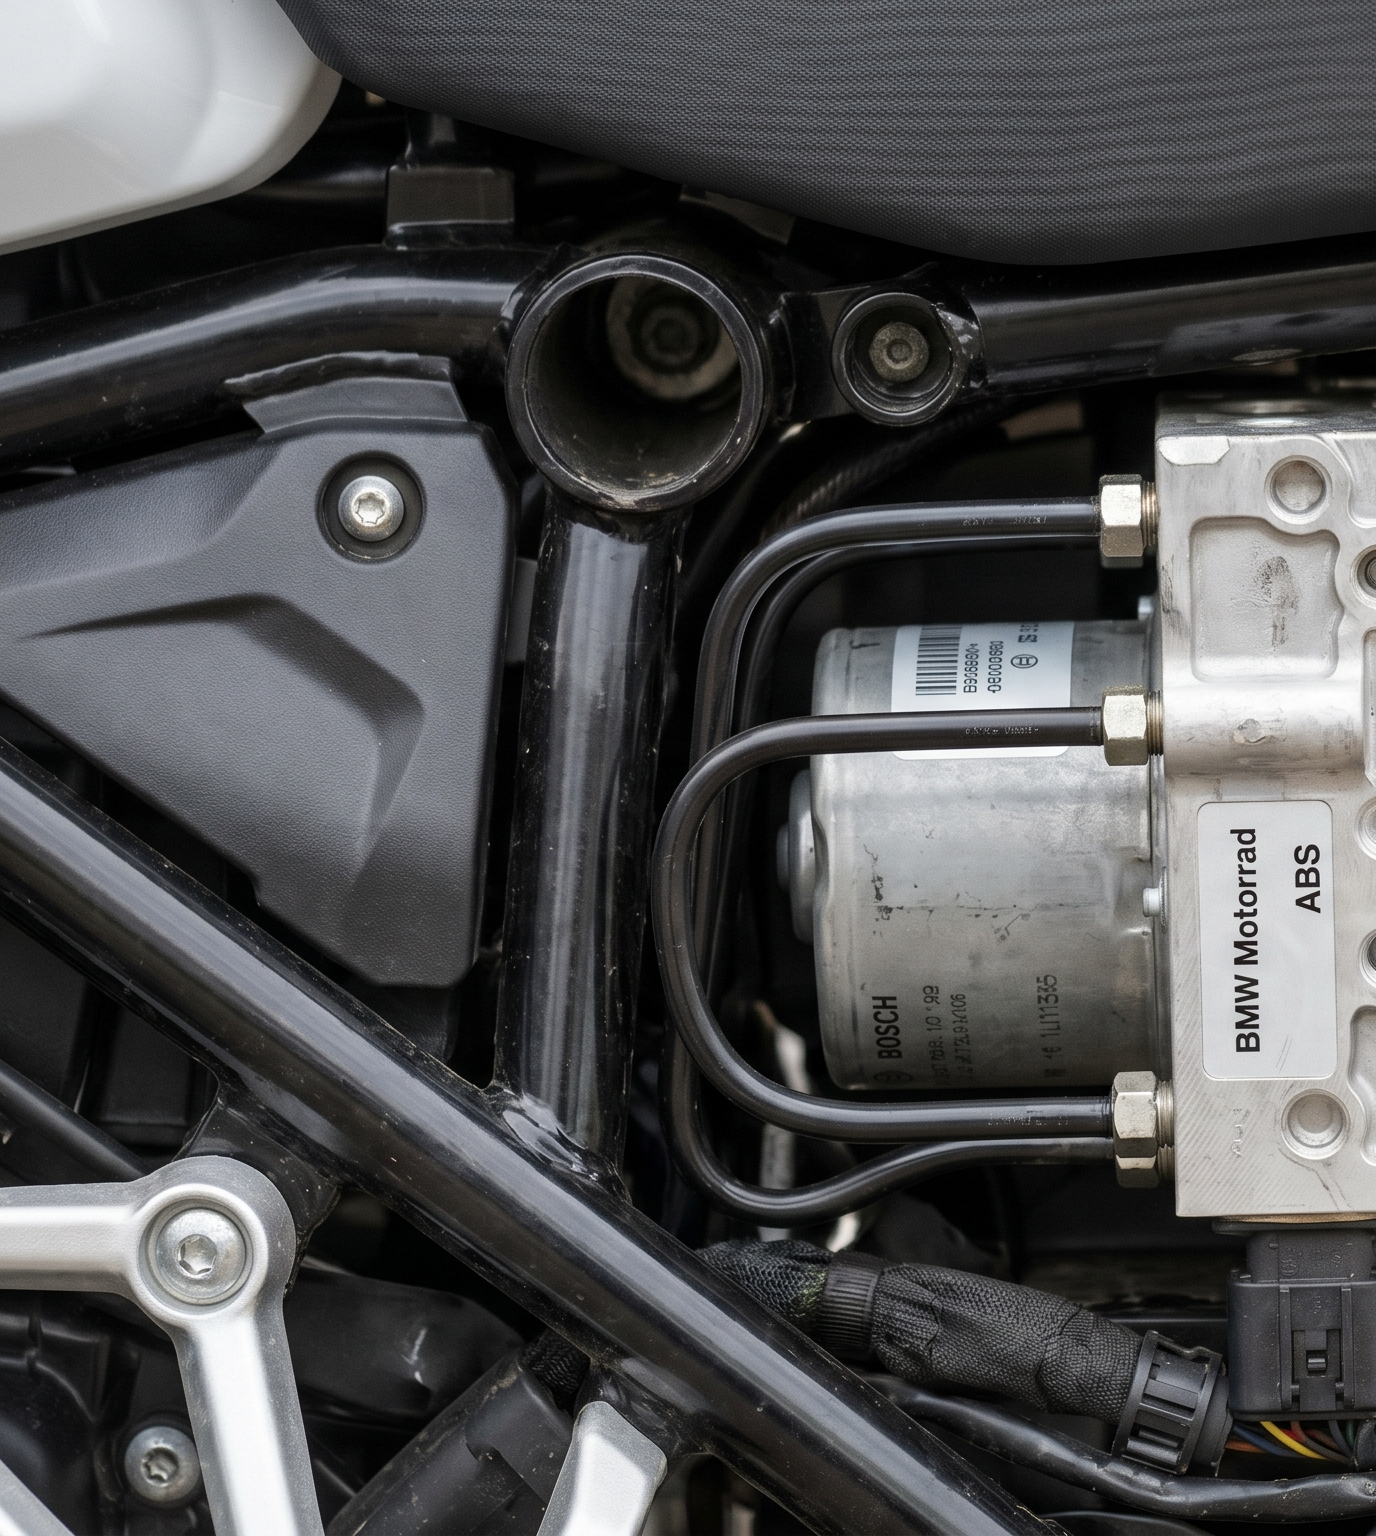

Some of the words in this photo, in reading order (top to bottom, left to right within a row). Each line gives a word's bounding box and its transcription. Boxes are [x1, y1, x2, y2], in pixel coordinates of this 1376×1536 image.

[1229, 828, 1259, 966] Motorrad
[1293, 844, 1321, 914] ABS
[871, 996, 903, 1060] BOSCH
[1234, 974, 1261, 1053] BMW
